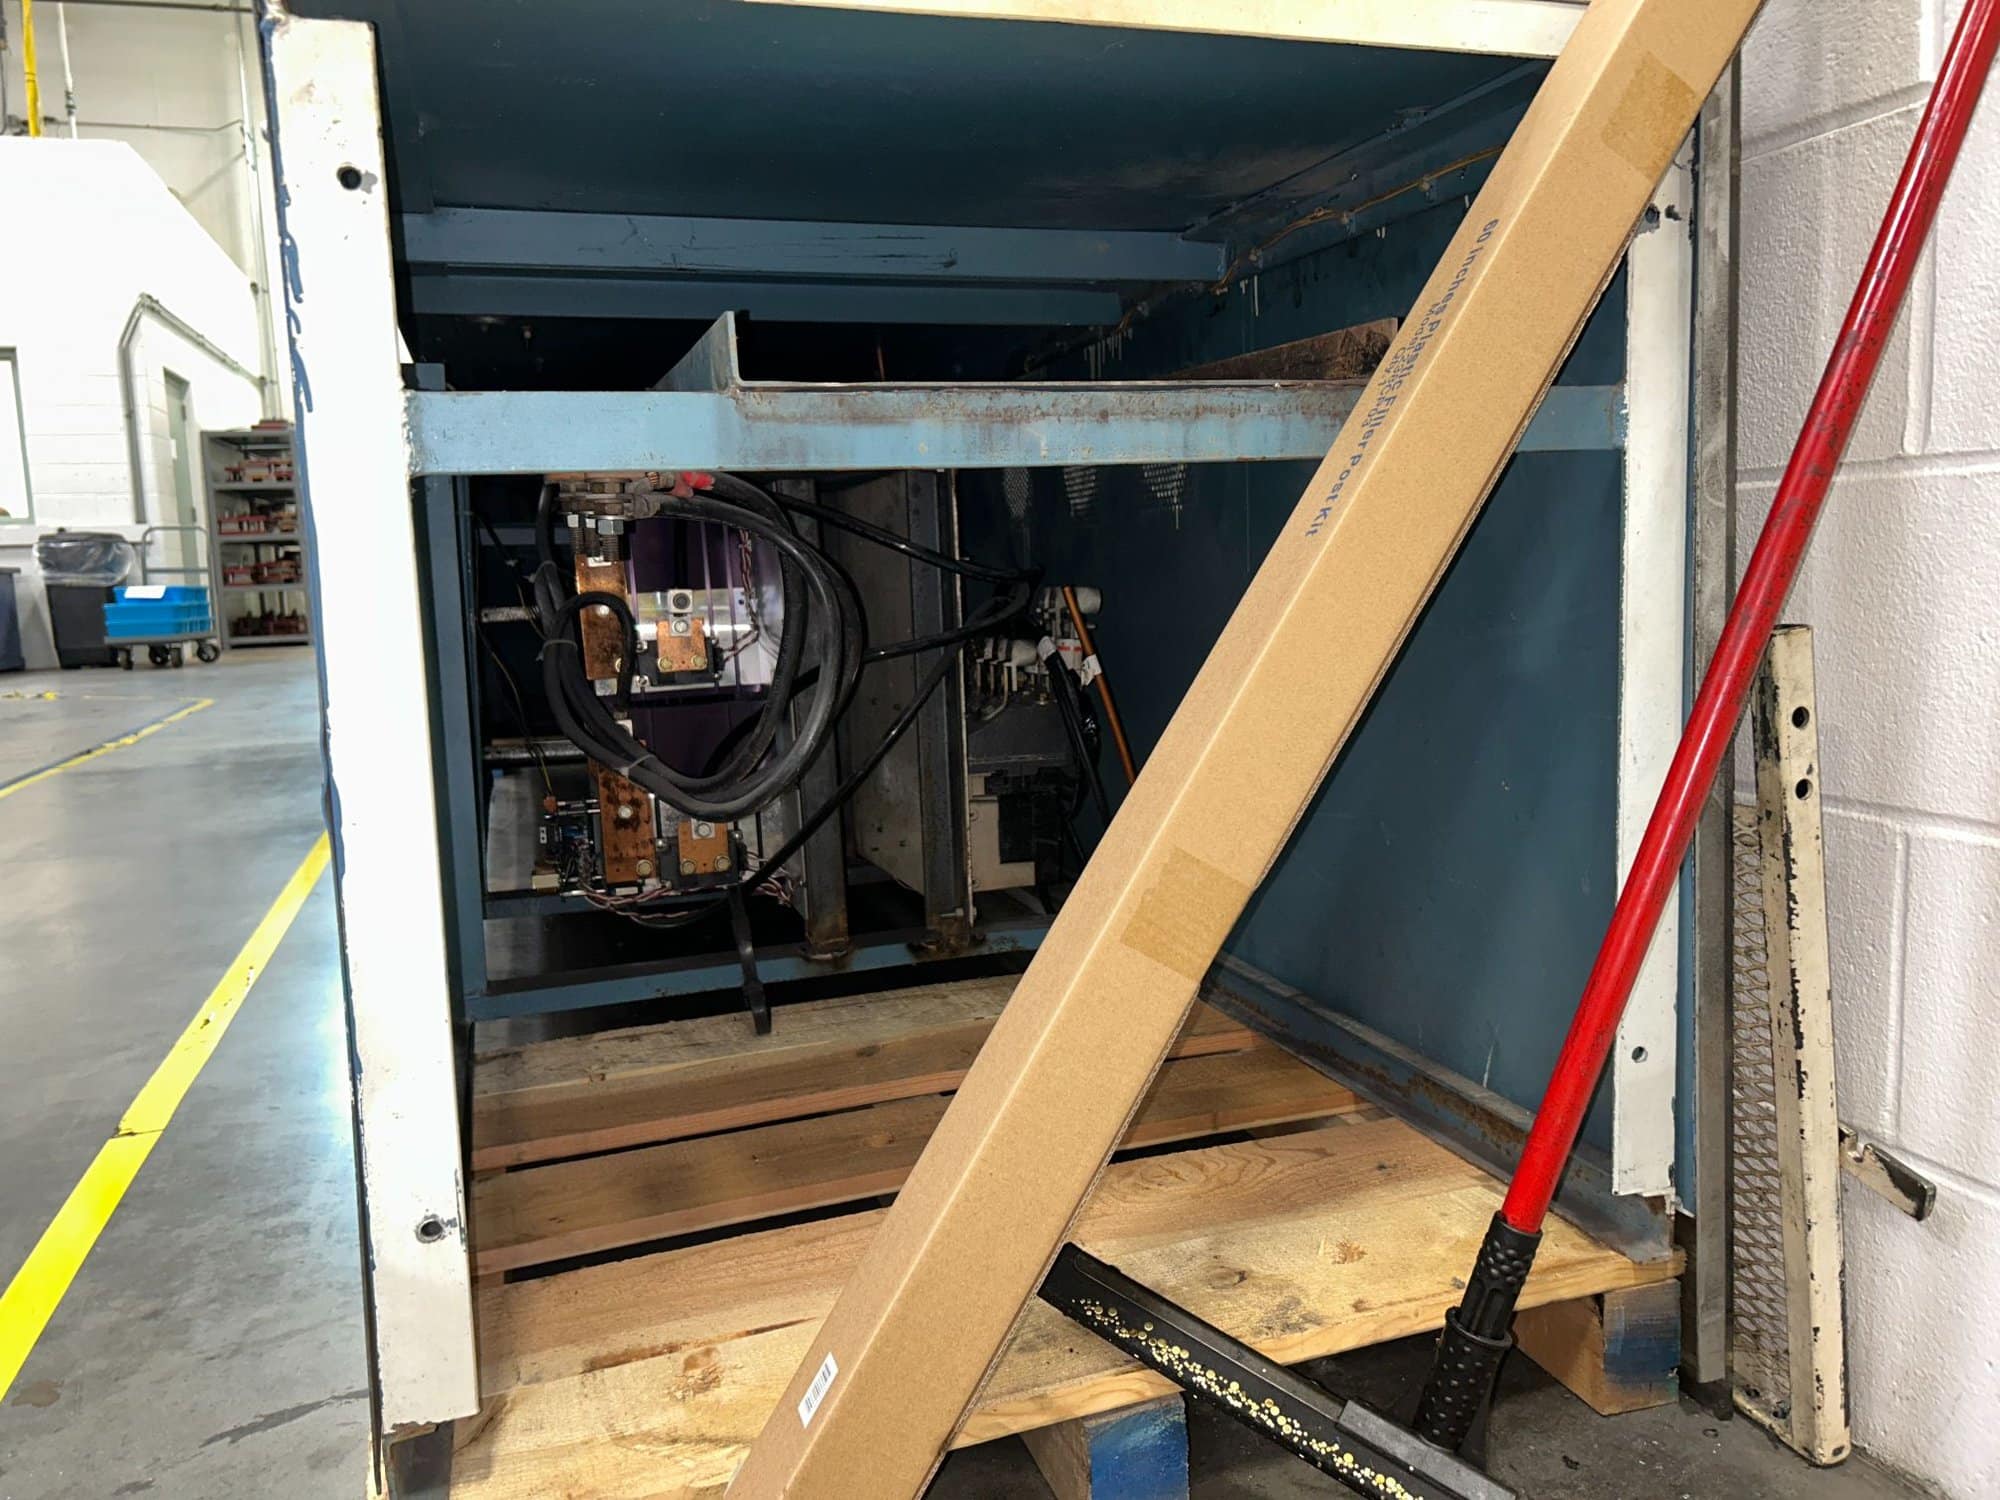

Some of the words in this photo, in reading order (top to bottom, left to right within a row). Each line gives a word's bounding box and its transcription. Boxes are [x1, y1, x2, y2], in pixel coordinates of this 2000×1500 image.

[1477, 219, 1498, 243] 60
[1391, 320, 1441, 391] Plastic
[1358, 395, 1397, 449] Filler
[1326, 453, 1363, 502] Post
[1305, 507, 1332, 535] Kit
